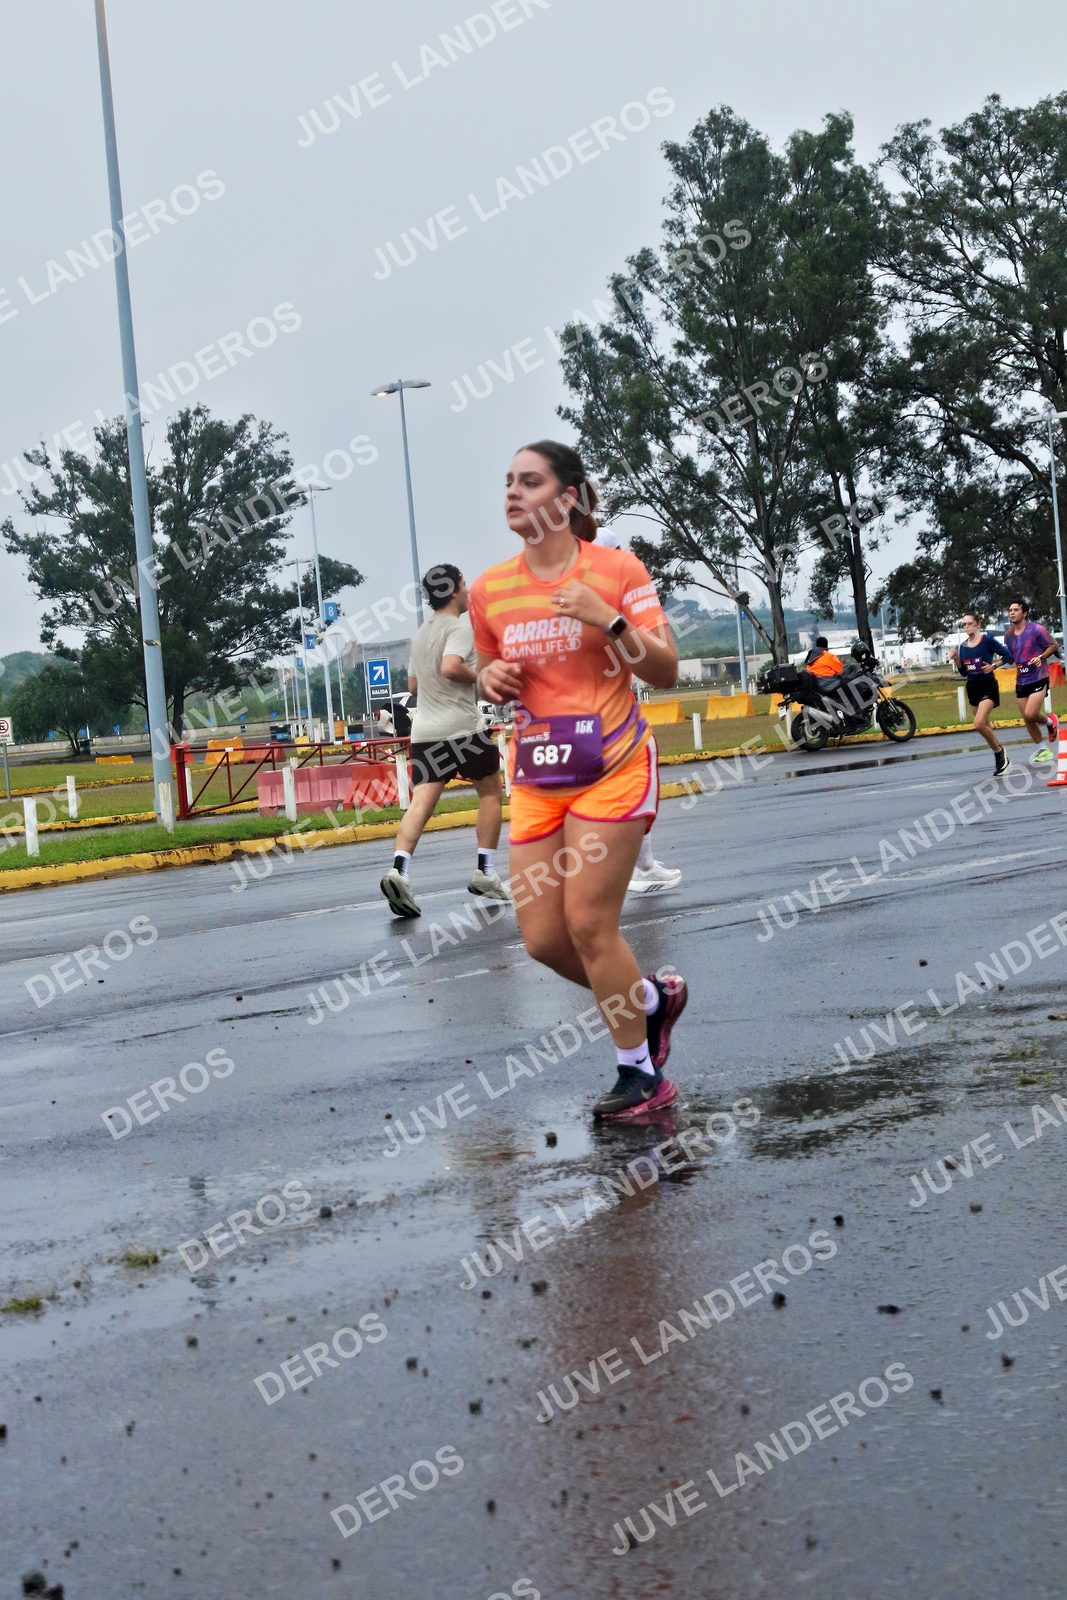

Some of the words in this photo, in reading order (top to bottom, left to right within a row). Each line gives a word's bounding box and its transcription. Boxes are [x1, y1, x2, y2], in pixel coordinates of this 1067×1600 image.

[503, 616, 583, 645] CARRERA
[502, 639, 565, 660] OMNILIFE
[532, 744, 573, 766] 687
